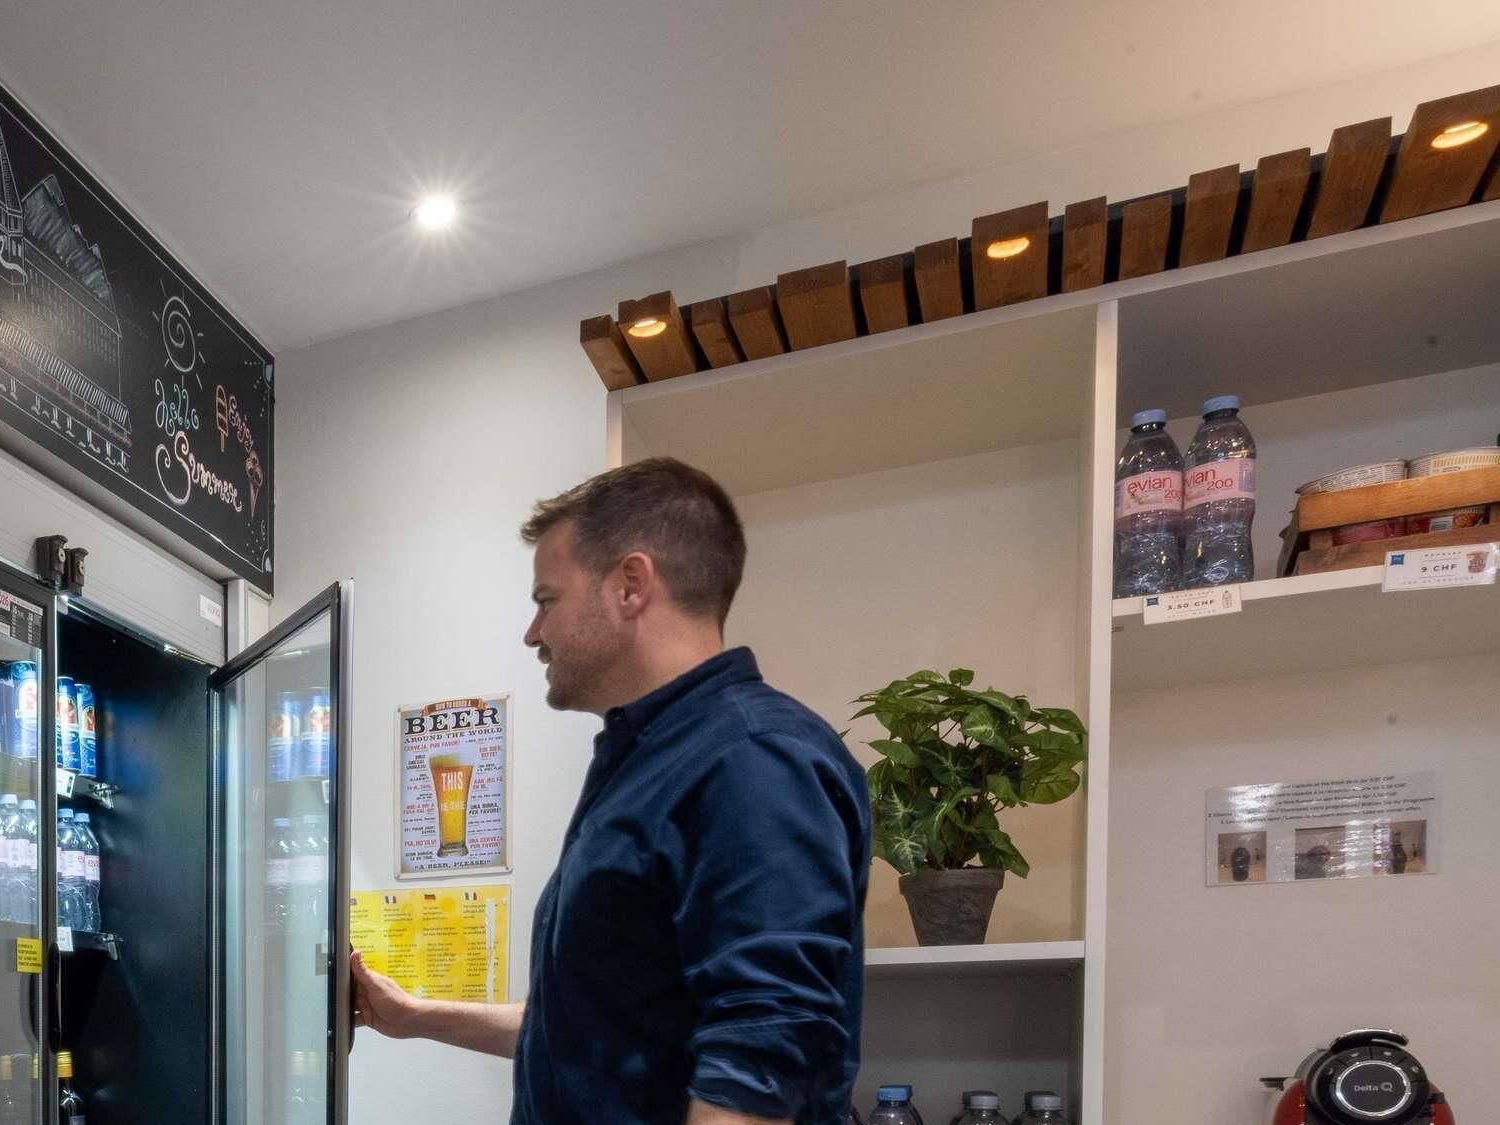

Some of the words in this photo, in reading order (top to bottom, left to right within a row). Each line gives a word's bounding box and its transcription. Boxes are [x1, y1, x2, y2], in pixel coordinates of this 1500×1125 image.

[155, 378, 200, 436] Hello
[155, 431, 243, 512] Summer
[1184, 468, 1216, 487] vian
[1128, 477, 1172, 494] evian
[1207, 478, 1234, 491] 200
[1433, 563, 1457, 572] CHF
[1194, 599, 1215, 607] CHF
[405, 708, 500, 735] BEER
[405, 735, 442, 744] AROUND
[469, 728, 502, 736] WORLD
[442, 771, 463, 792] THIS
[1380, 1082, 1393, 1092] Q
